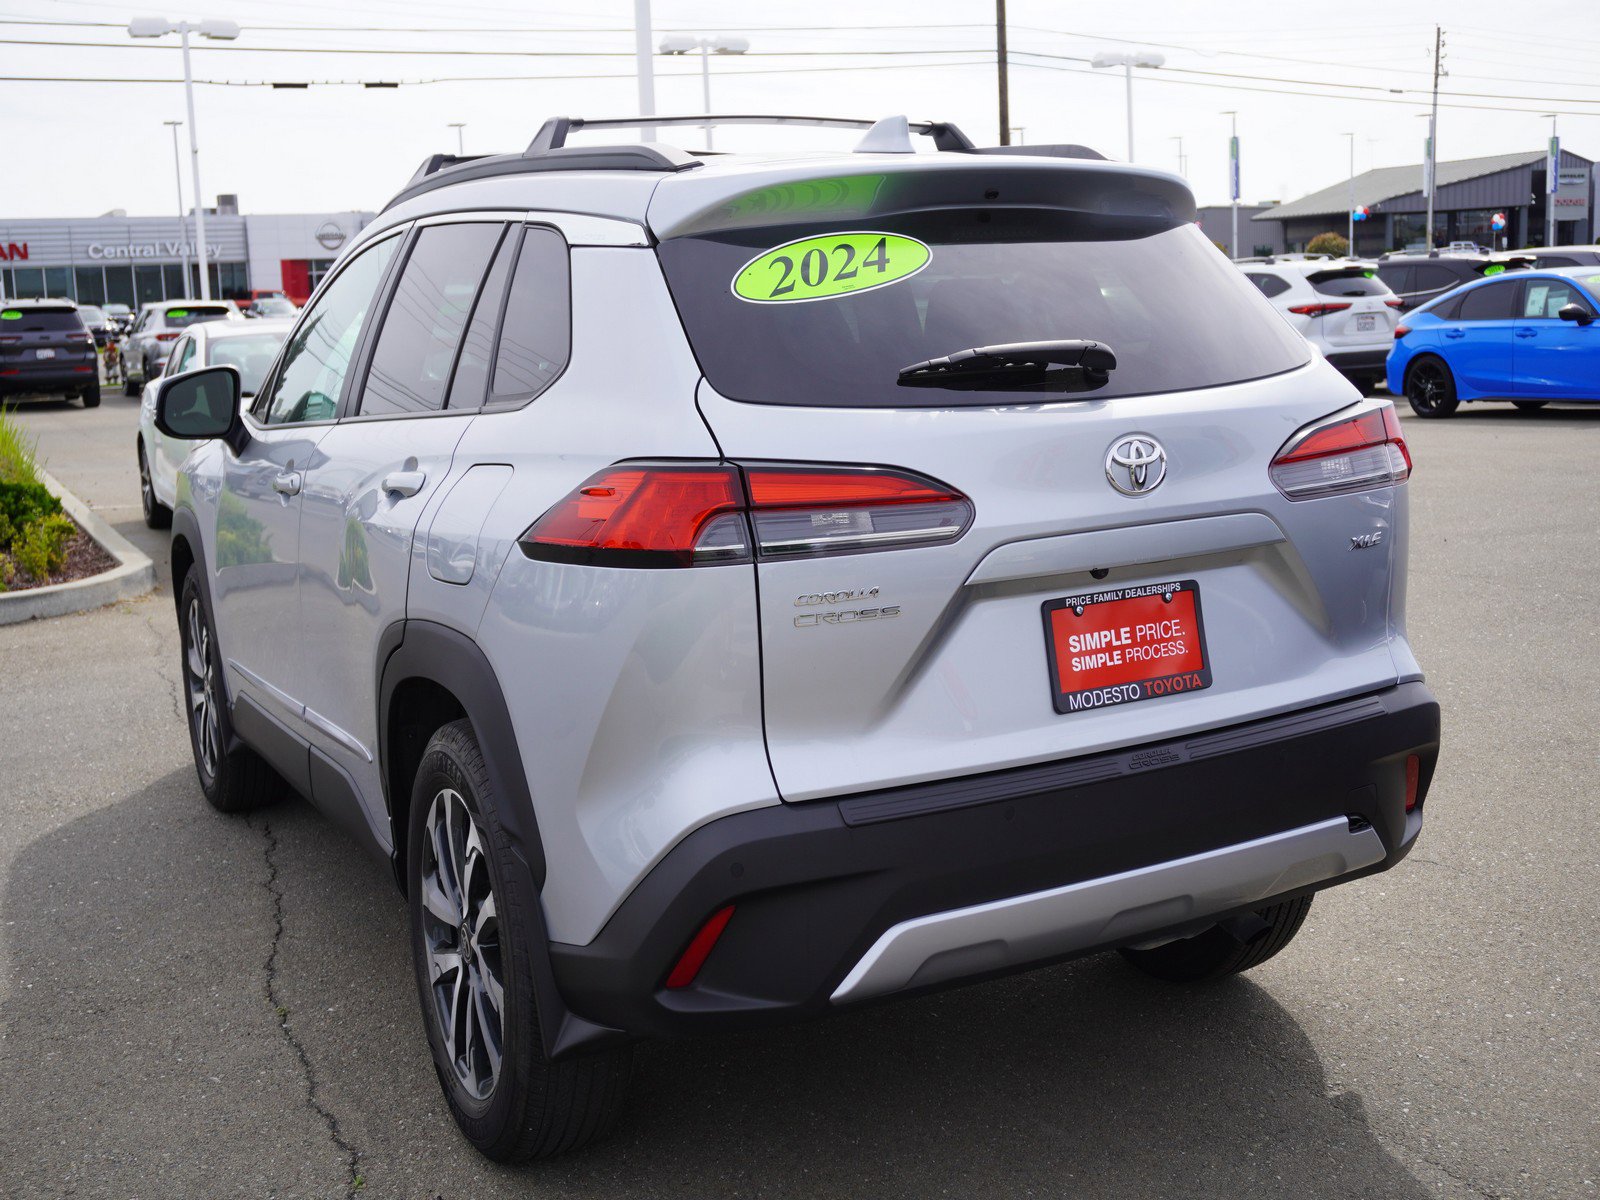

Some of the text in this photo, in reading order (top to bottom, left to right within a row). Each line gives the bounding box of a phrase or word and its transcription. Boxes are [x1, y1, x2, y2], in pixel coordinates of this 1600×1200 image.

[88, 240, 223, 260] Central Valey
[768, 237, 891, 299] 2024
[1347, 531, 1382, 551] XLE
[793, 585, 881, 607] COROLLA
[1065, 582, 1181, 608] PRICE FAMILY DEALERSHIPS
[793, 605, 901, 628] CROSS
[1068, 619, 1186, 653] SIMPLE PRICE.
[1071, 640, 1189, 672] SIMPLE PROCESS.
[1068, 673, 1202, 710] MODESTO TOYOTA
[1128, 754, 1181, 770] CROSS
